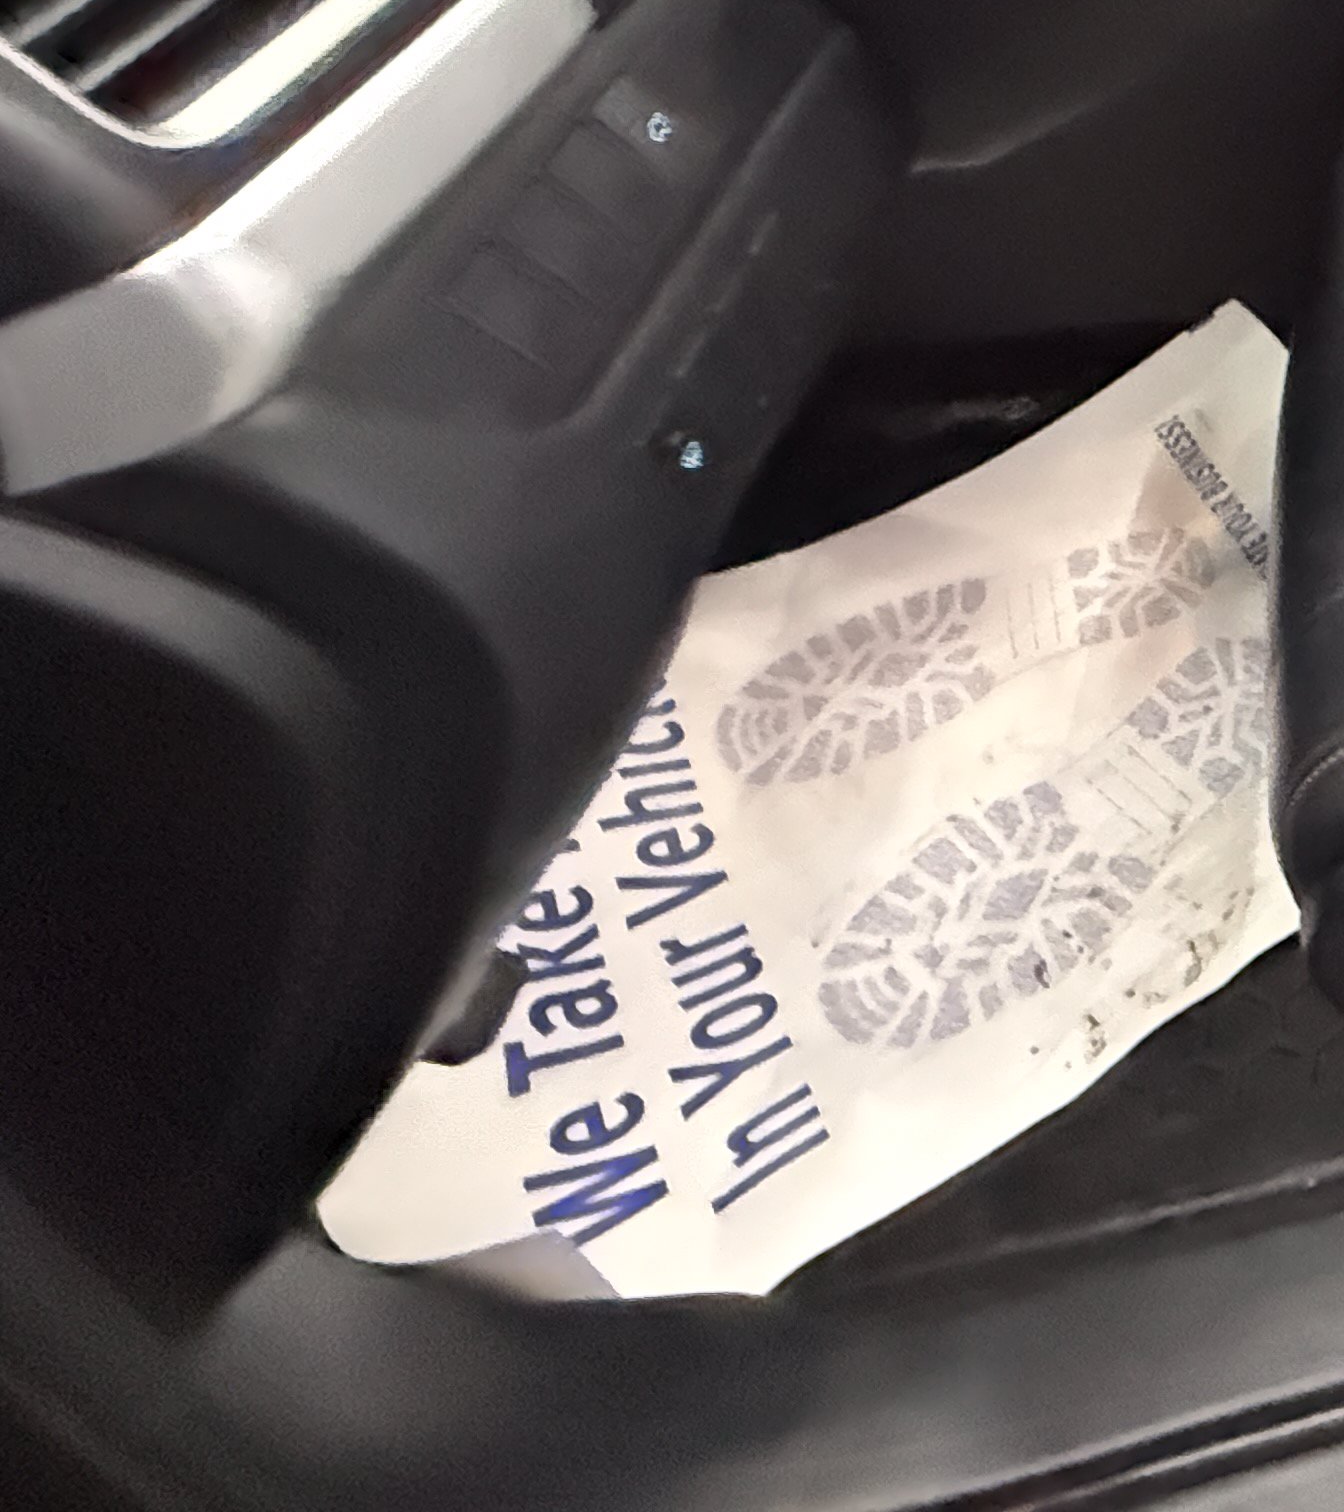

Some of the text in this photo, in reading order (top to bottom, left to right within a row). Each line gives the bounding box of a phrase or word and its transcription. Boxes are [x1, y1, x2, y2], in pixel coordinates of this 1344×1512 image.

[1154, 414, 1228, 502] BUSINESS!
[1211, 490, 1255, 542] YOUR
[503, 885, 669, 1249] We Take
[597, 697, 830, 1215] In Your Vehic
